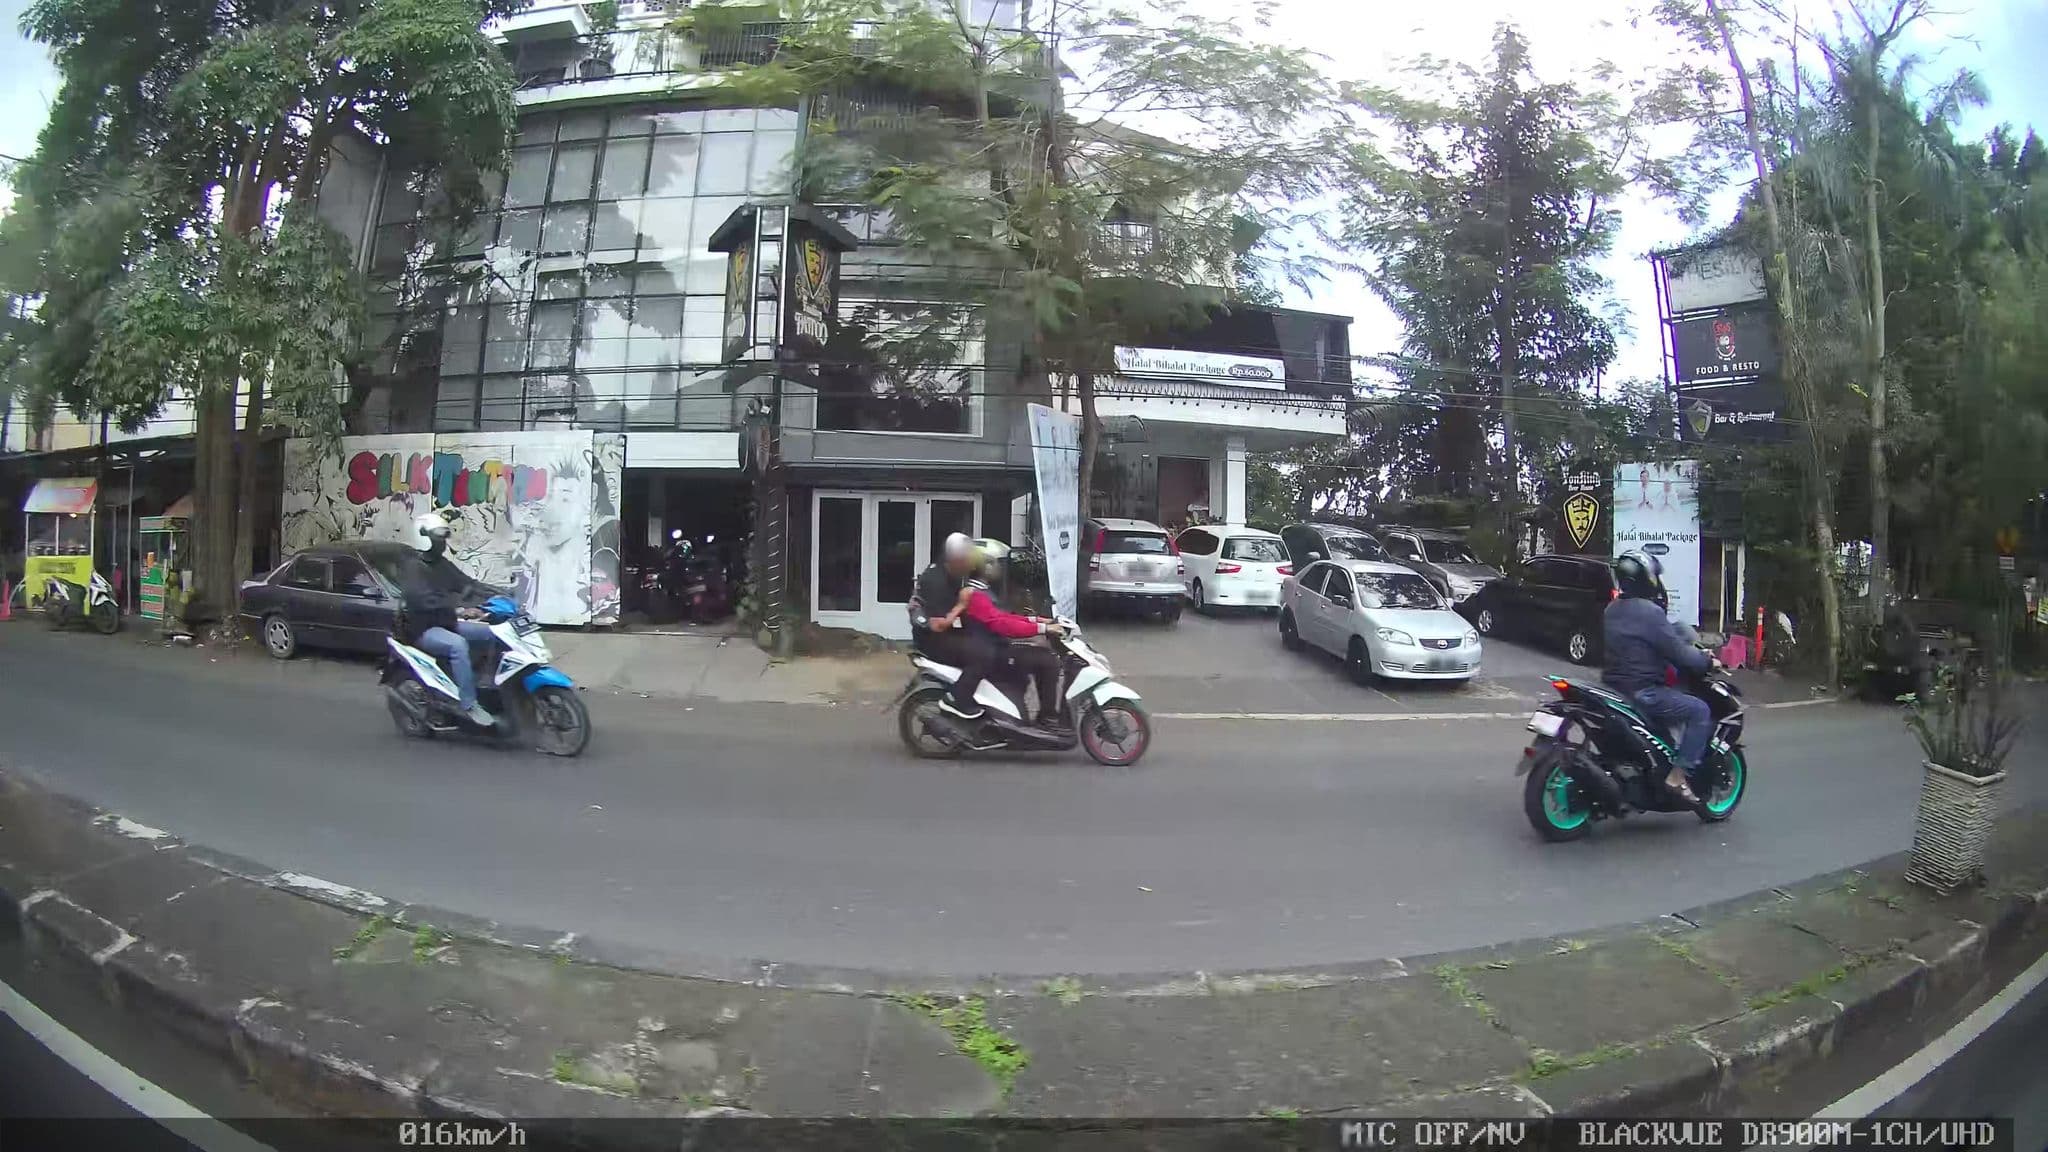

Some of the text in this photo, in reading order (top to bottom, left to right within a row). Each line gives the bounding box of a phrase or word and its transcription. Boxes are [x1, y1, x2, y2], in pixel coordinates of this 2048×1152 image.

[1190, 362, 1226, 375] Package
[1696, 361, 1760, 375] FOOD & RESTO
[1714, 413, 1727, 424] Bar
[346, 451, 433, 505] SILK
[1616, 531, 1698, 544] Halal Bihalal Package
